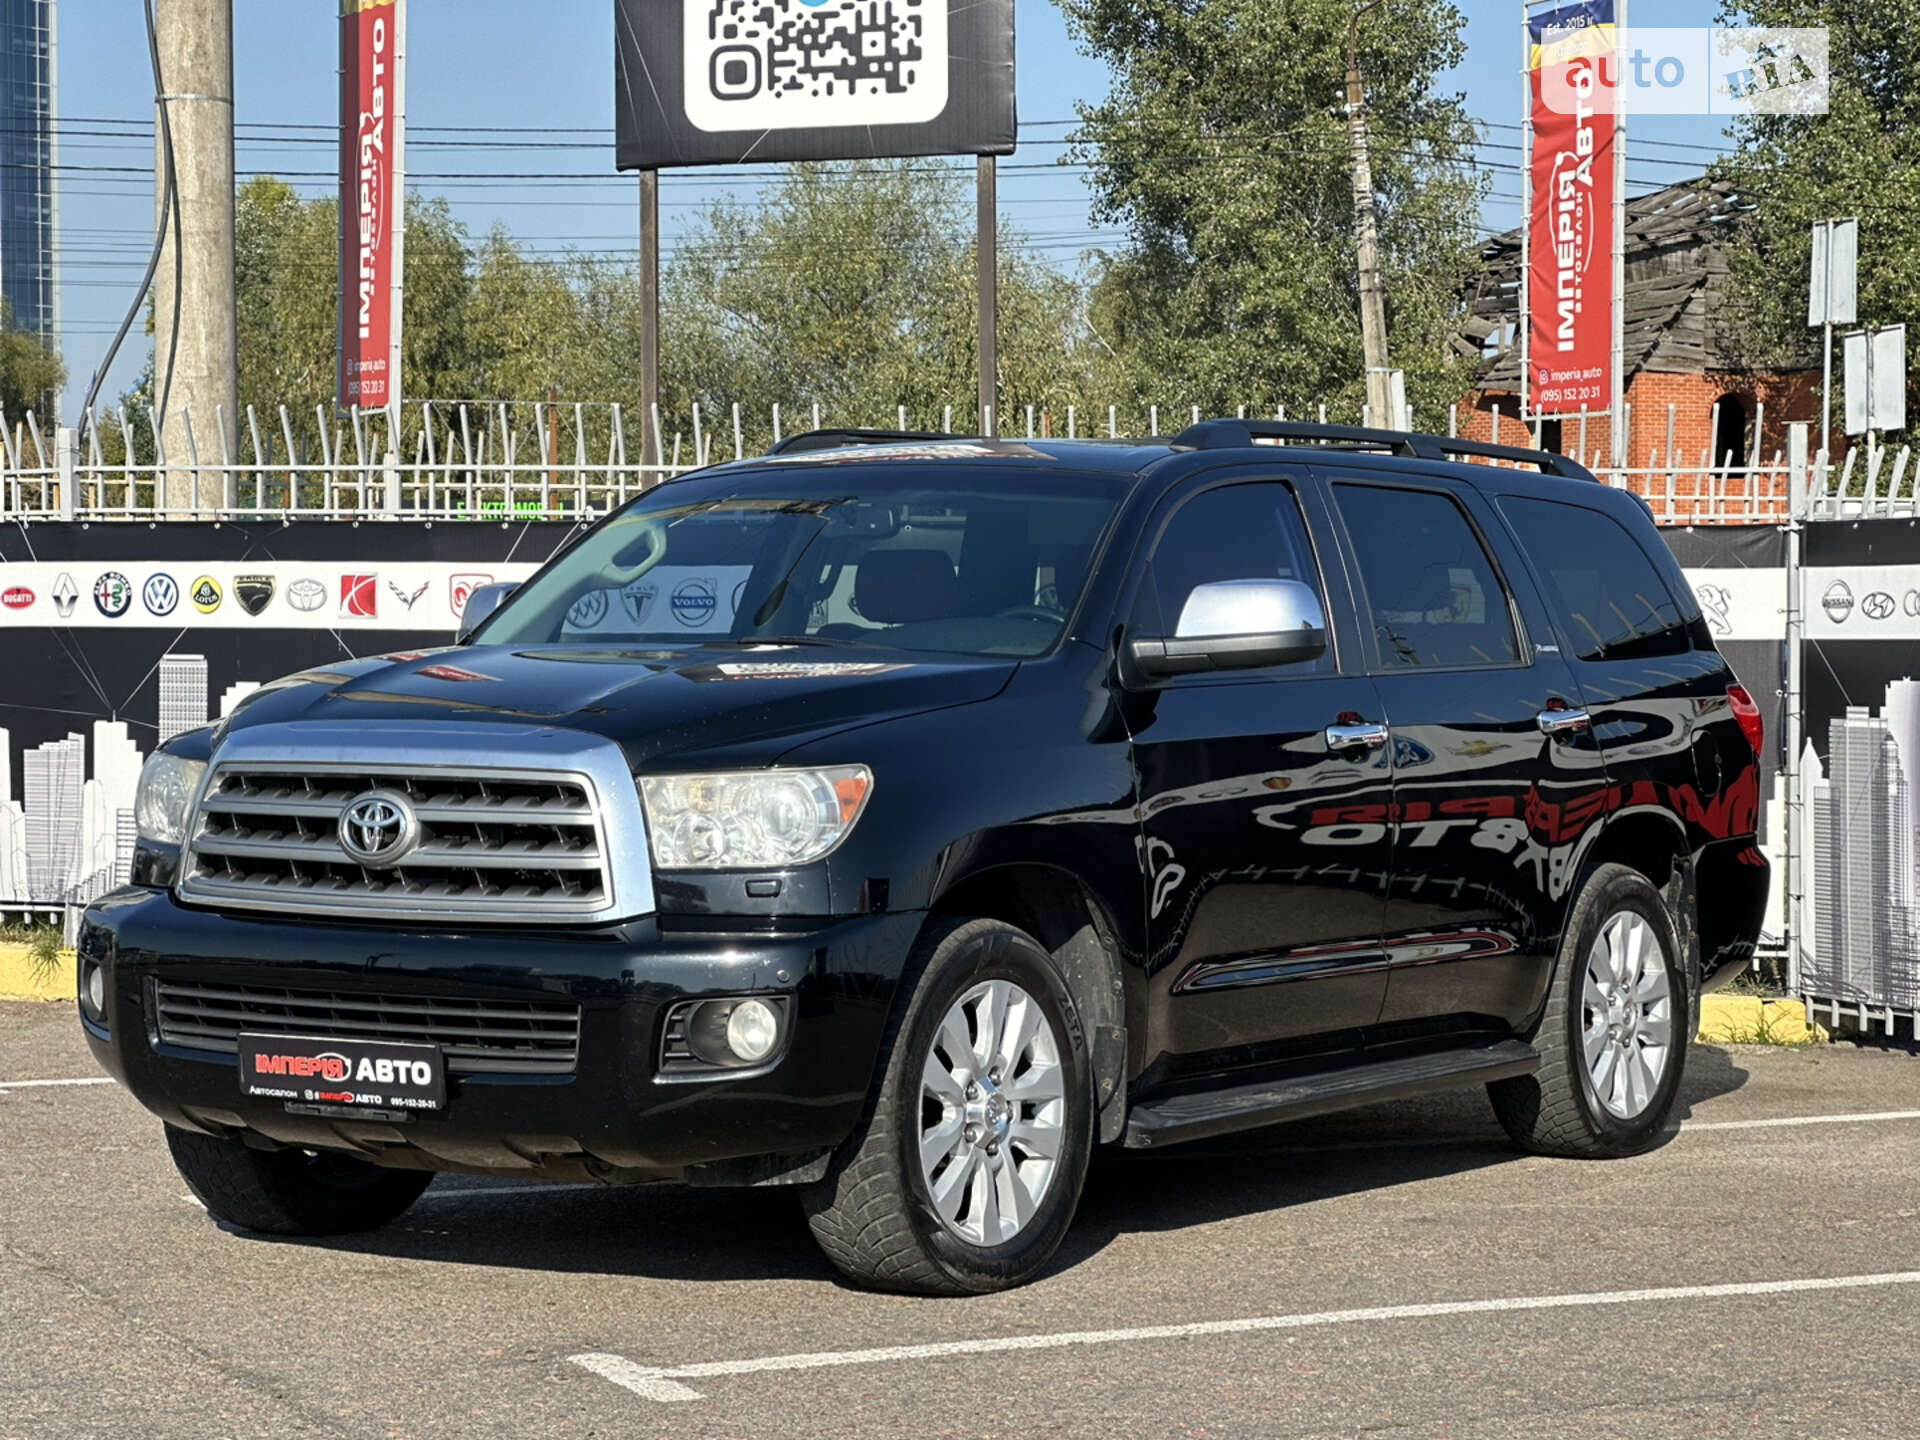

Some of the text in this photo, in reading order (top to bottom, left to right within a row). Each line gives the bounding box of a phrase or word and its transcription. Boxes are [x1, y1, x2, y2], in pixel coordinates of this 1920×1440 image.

[1565, 15, 1585, 31] 2015
[372, 17, 384, 155] АВТО
[1576, 68, 1594, 188] АВТО
[1541, 385, 1601, 403] (095) 152 20 31
[673, 597, 714, 607] VOLVO
[1057, 993, 1083, 1051] ZETA
[255, 1054, 432, 1086] ІМПЕРІЯ АВТО
[355, 1093, 382, 1105] АВТО
